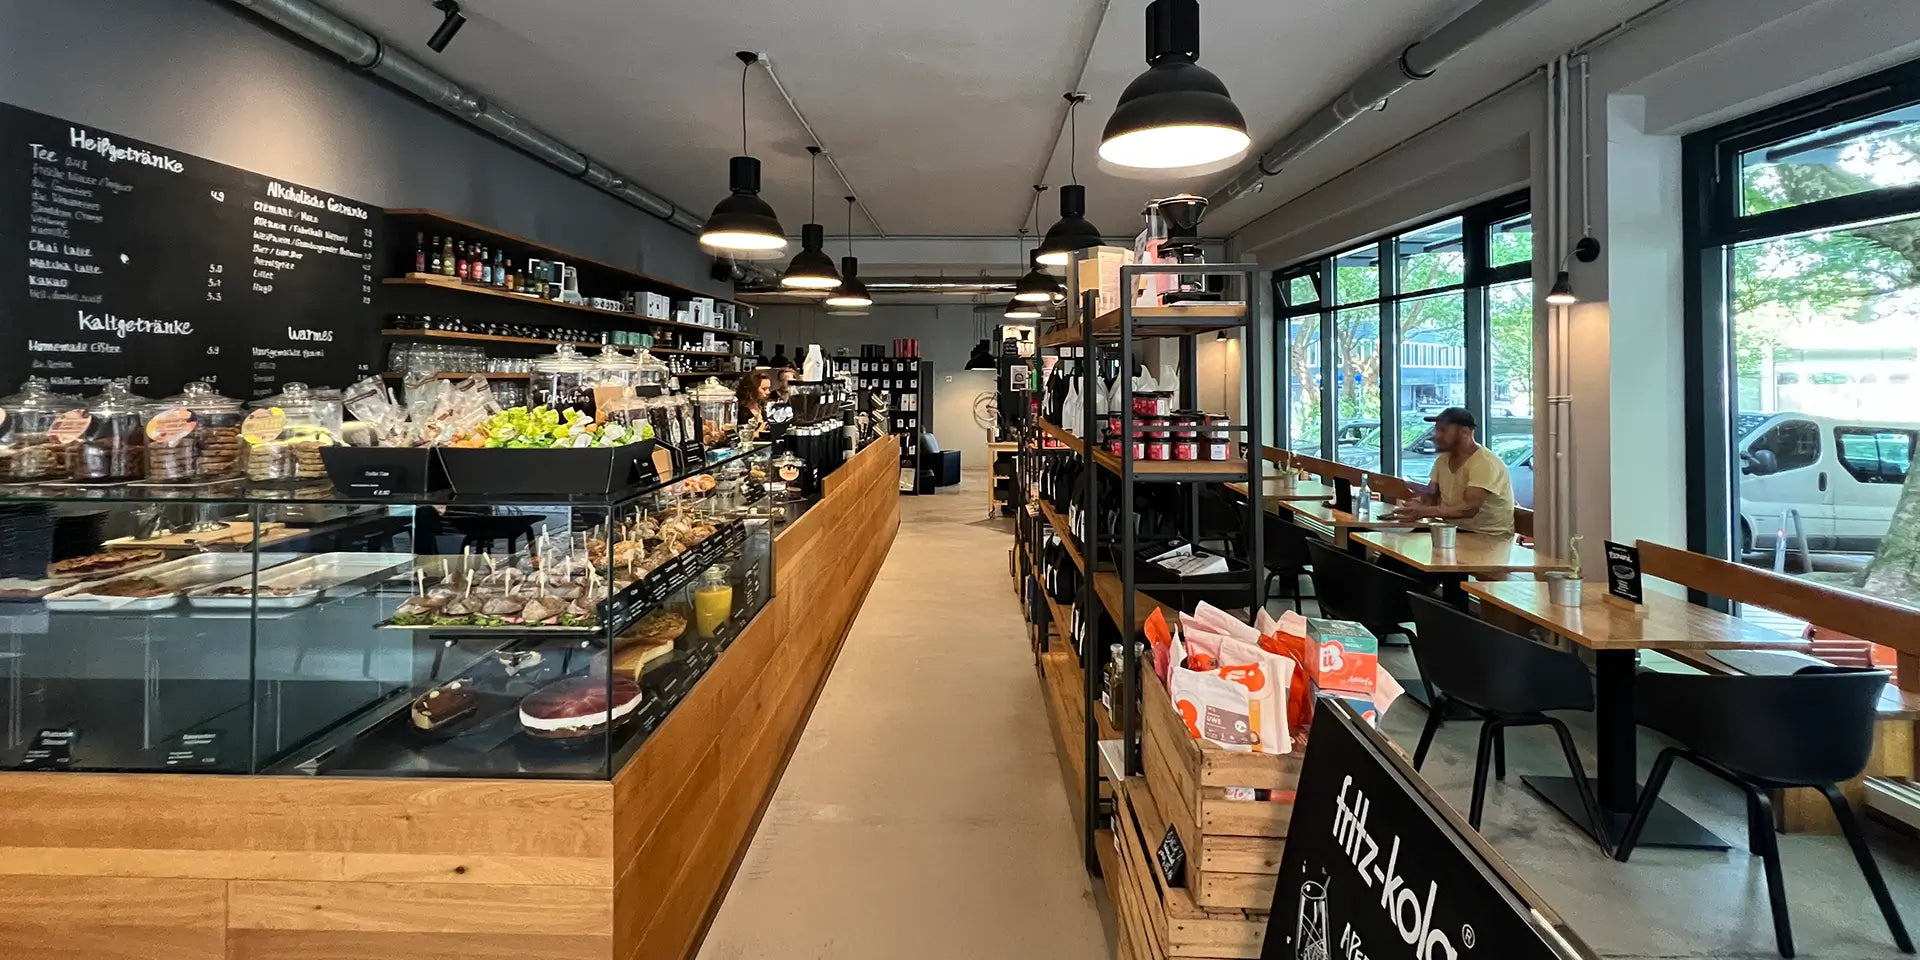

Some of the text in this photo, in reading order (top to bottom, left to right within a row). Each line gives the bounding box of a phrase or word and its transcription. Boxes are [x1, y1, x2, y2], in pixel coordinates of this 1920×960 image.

[29, 143, 58, 162] Tee
[70, 127, 184, 173] Heißgetränke
[267, 181, 325, 209] Alkoholische
[29, 240, 58, 253] Chai
[29, 275, 68, 287] Kakao
[78, 310, 194, 339] Kaltgetränke
[28, 340, 88, 352] Homemade
